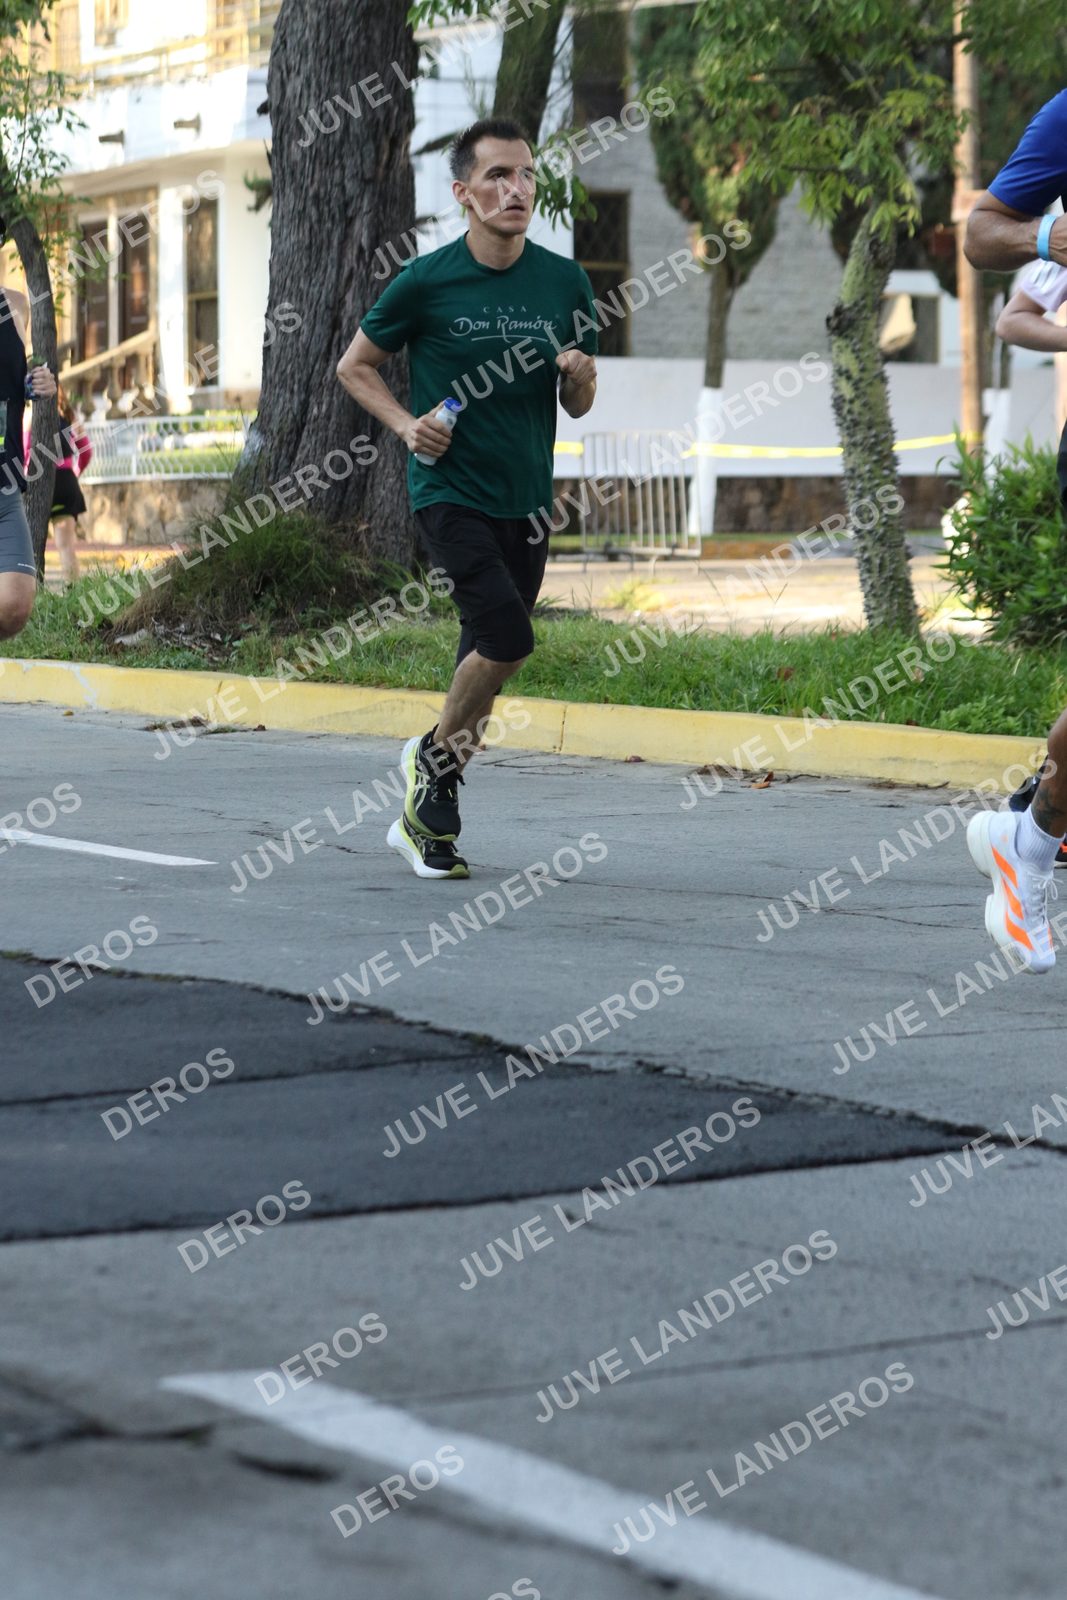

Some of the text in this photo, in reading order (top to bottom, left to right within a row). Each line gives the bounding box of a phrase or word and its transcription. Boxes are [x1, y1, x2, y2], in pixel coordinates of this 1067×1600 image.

[483, 305, 528, 313] CASA
[449, 315, 558, 344] Don Ramón
